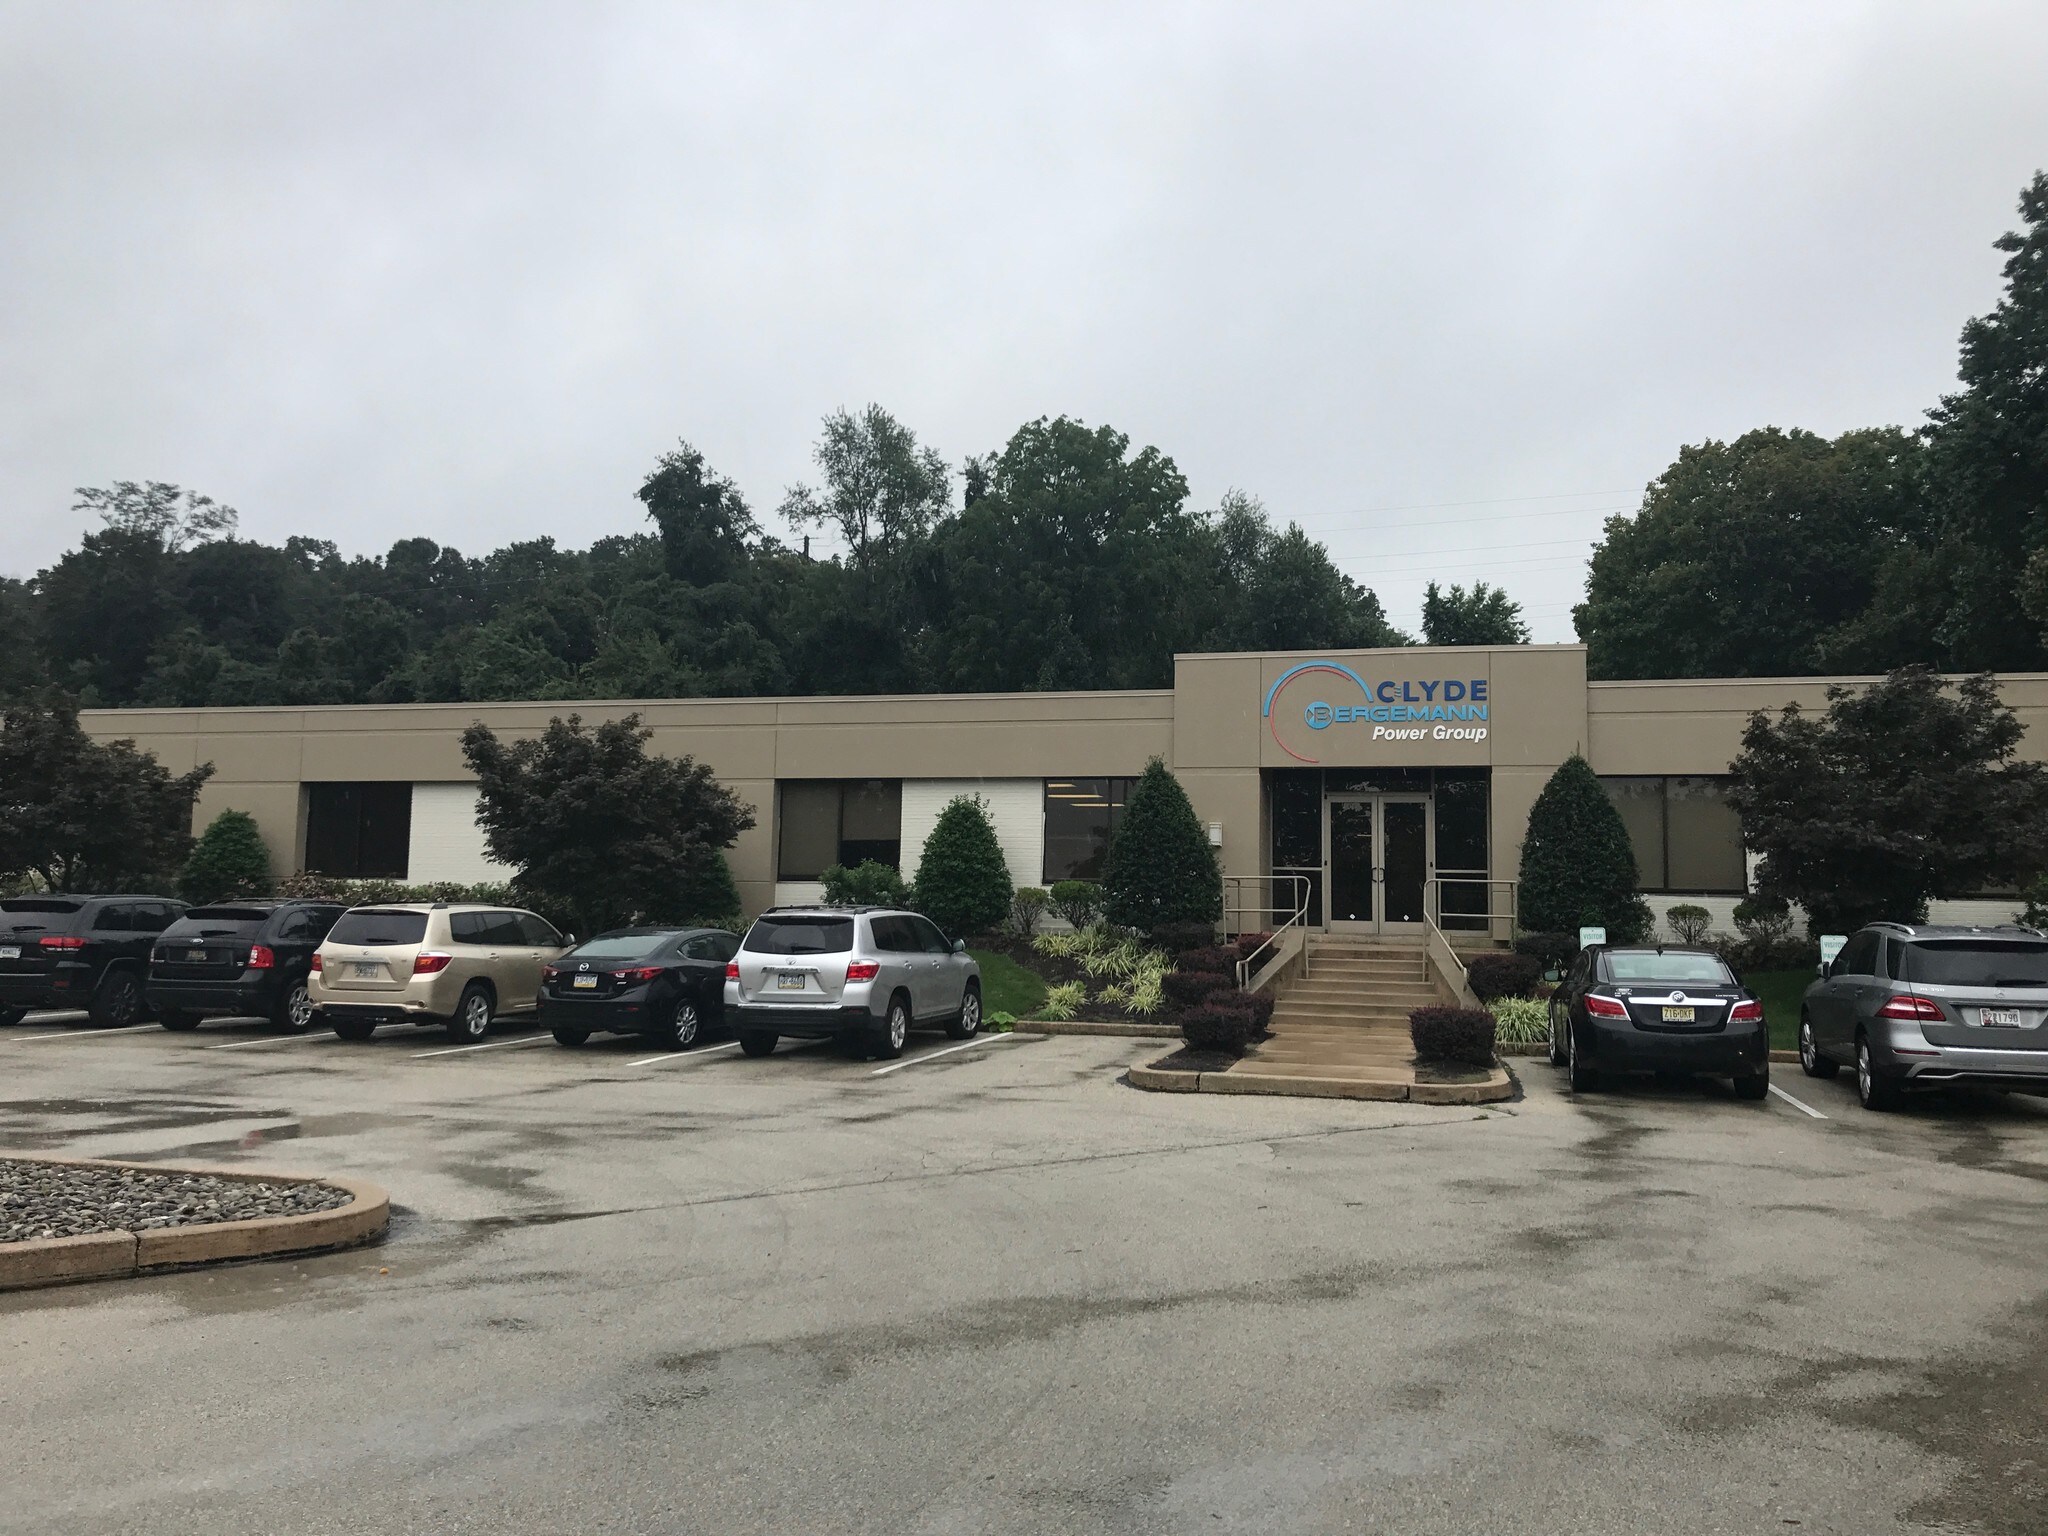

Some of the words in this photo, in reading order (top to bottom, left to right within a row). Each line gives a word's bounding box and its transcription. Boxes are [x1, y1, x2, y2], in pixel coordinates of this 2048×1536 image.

[1377, 680, 1488, 703] CLYDE
[1307, 703, 1488, 725] BERGEMANN
[1372, 726, 1428, 741] Power
[1433, 725, 1488, 743] Group
